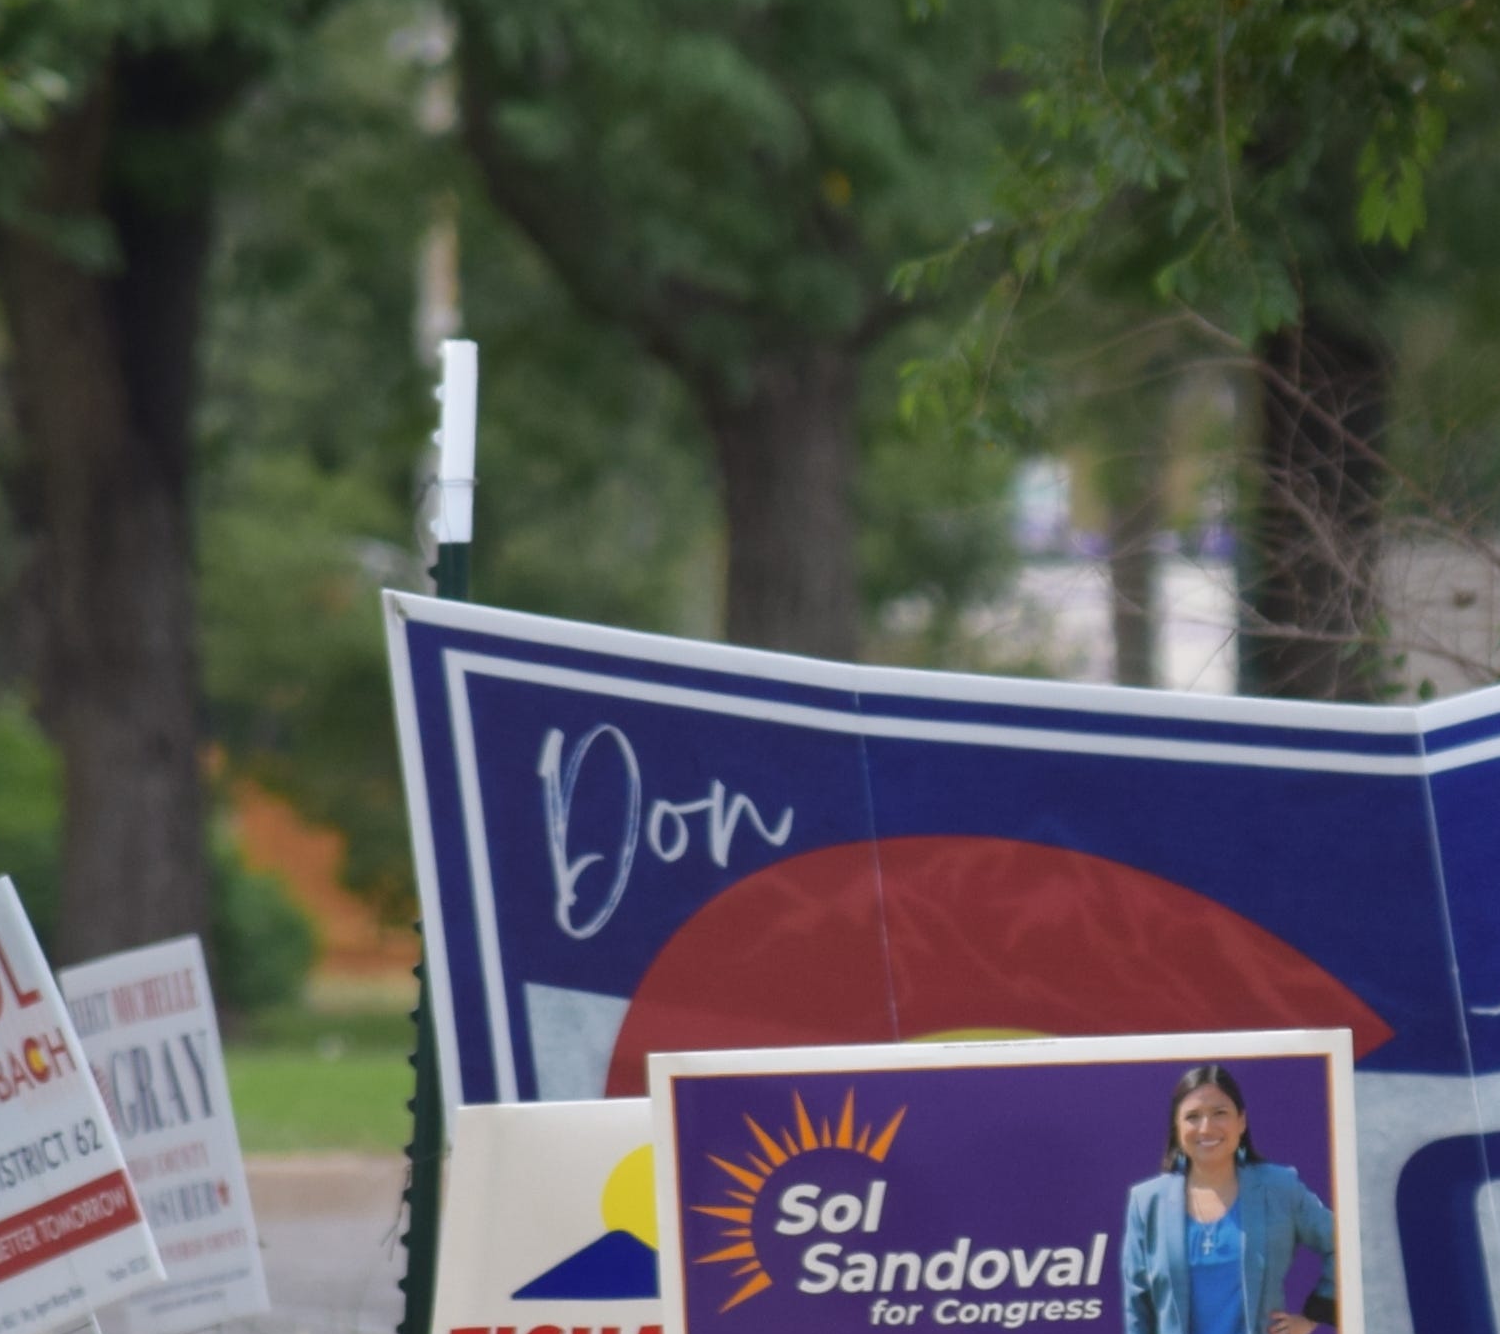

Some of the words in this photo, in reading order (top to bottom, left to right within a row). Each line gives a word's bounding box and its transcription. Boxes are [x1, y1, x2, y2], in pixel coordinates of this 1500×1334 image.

[537, 722, 794, 941] Don
[112, 1030, 214, 1140] GRAY
[74, 1118, 104, 1155] 62
[38, 1186, 130, 1244] TOMORROW
[774, 1179, 887, 1236] Sol
[796, 1232, 1108, 1295] Sandoval
[870, 1298, 923, 1326] for
[932, 1297, 1102, 1329] Congress
